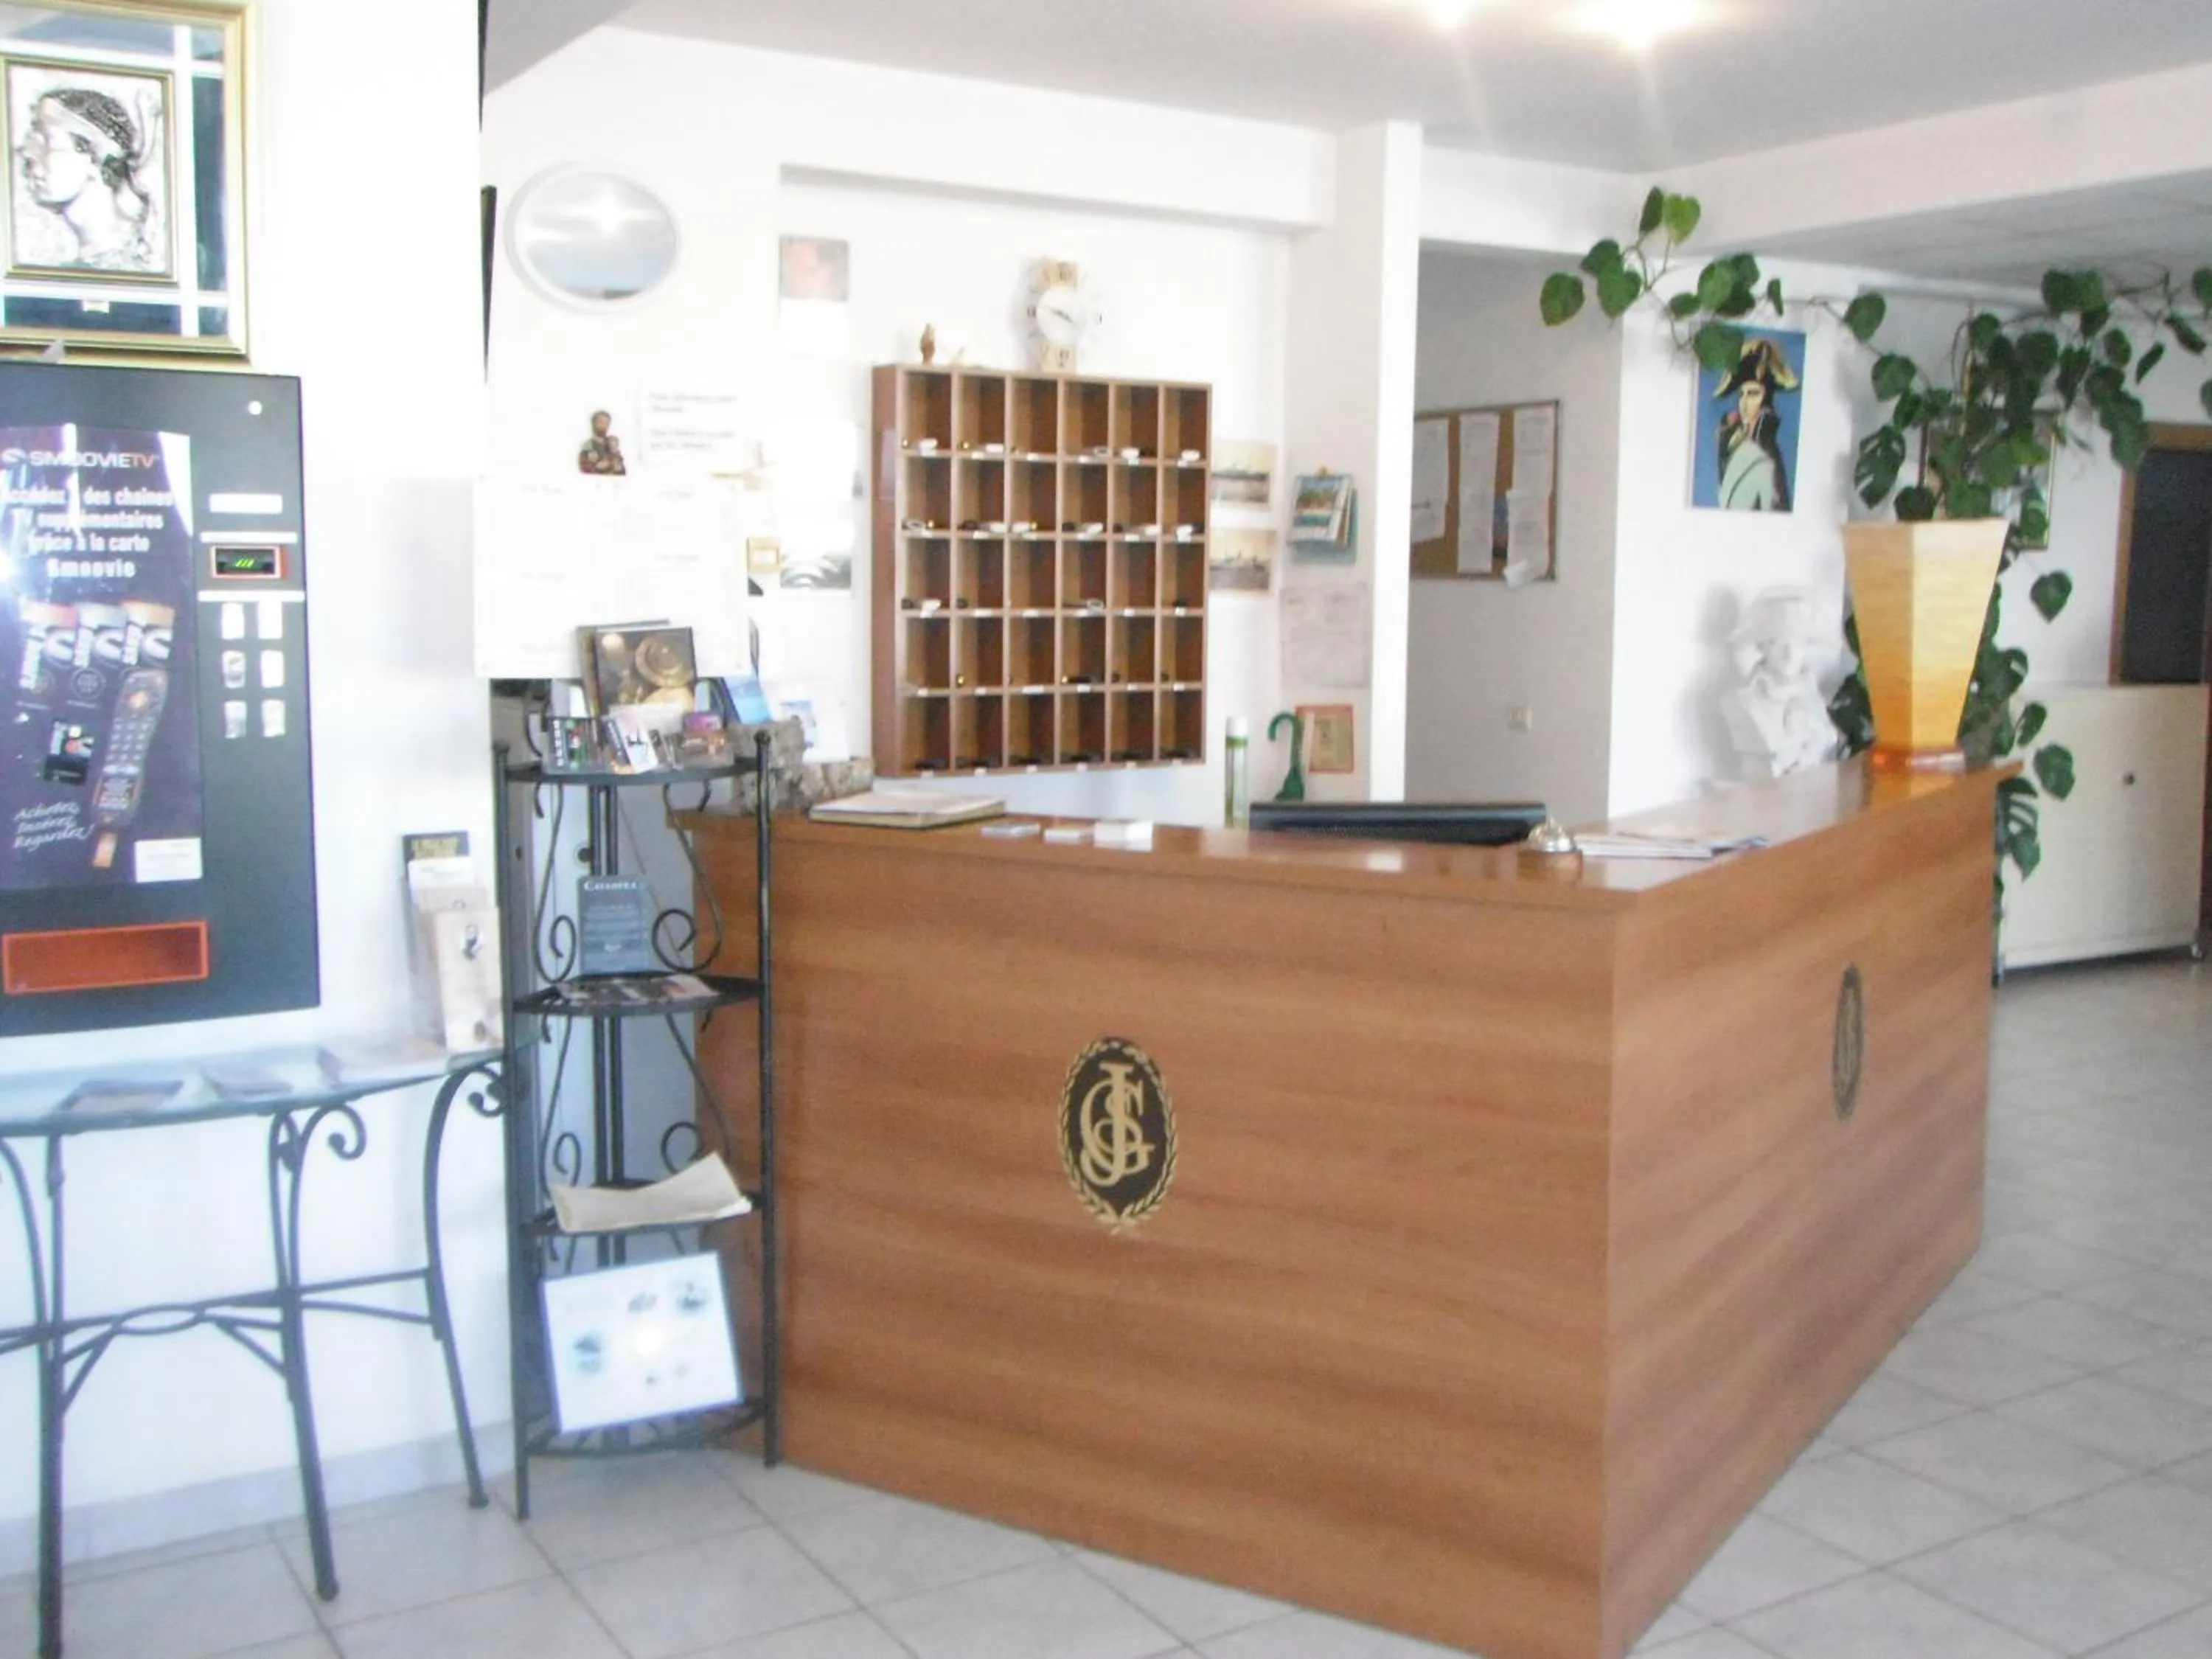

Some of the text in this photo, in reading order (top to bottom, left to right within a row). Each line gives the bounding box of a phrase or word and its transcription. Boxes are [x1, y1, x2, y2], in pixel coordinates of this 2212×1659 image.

[90, 532, 105, 552] la
[109, 534, 150, 552] carte
[47, 557, 136, 577] Smoovie
